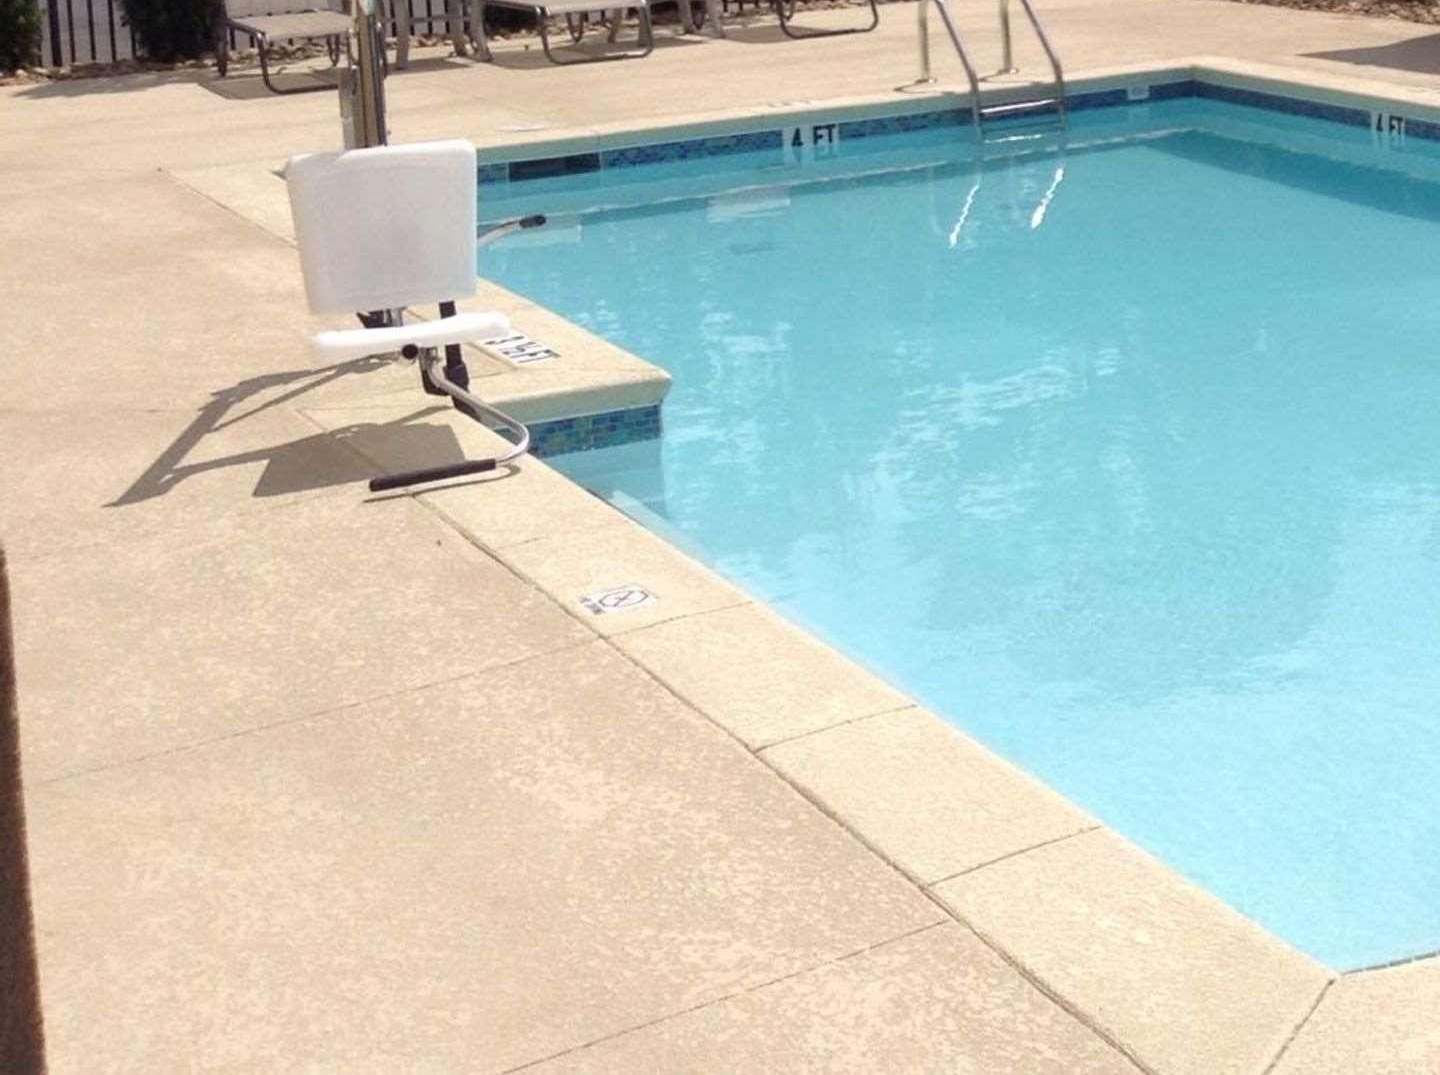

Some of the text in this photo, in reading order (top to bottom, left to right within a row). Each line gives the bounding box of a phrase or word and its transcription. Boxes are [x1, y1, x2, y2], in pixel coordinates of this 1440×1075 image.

[791, 123, 836, 146] 4 FT
[1389, 115, 1403, 135] FT
